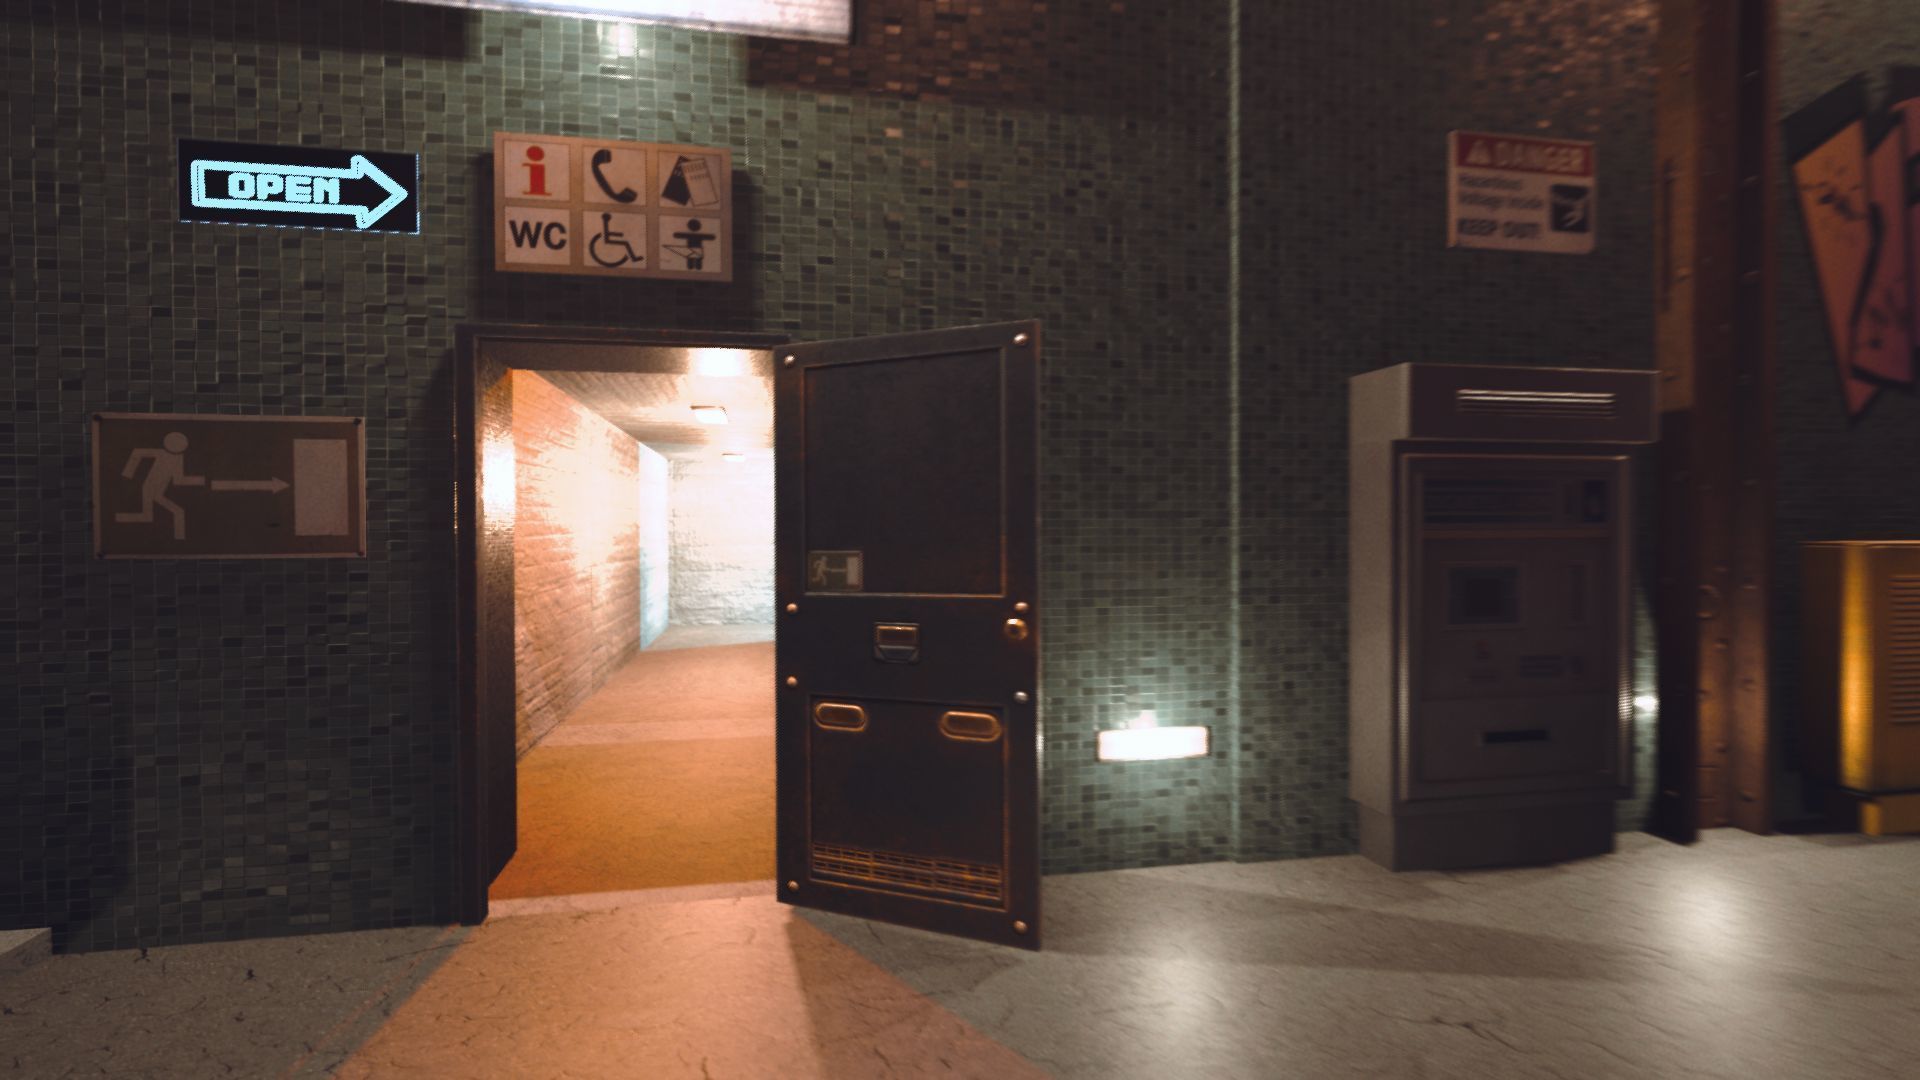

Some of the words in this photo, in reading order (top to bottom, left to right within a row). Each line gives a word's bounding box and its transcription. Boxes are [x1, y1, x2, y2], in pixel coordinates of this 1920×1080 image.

[1495, 141, 1585, 172] DANGER
[227, 172, 340, 204] OPEN
[509, 220, 567, 250] WC
[1458, 219, 1498, 236] KEEP
